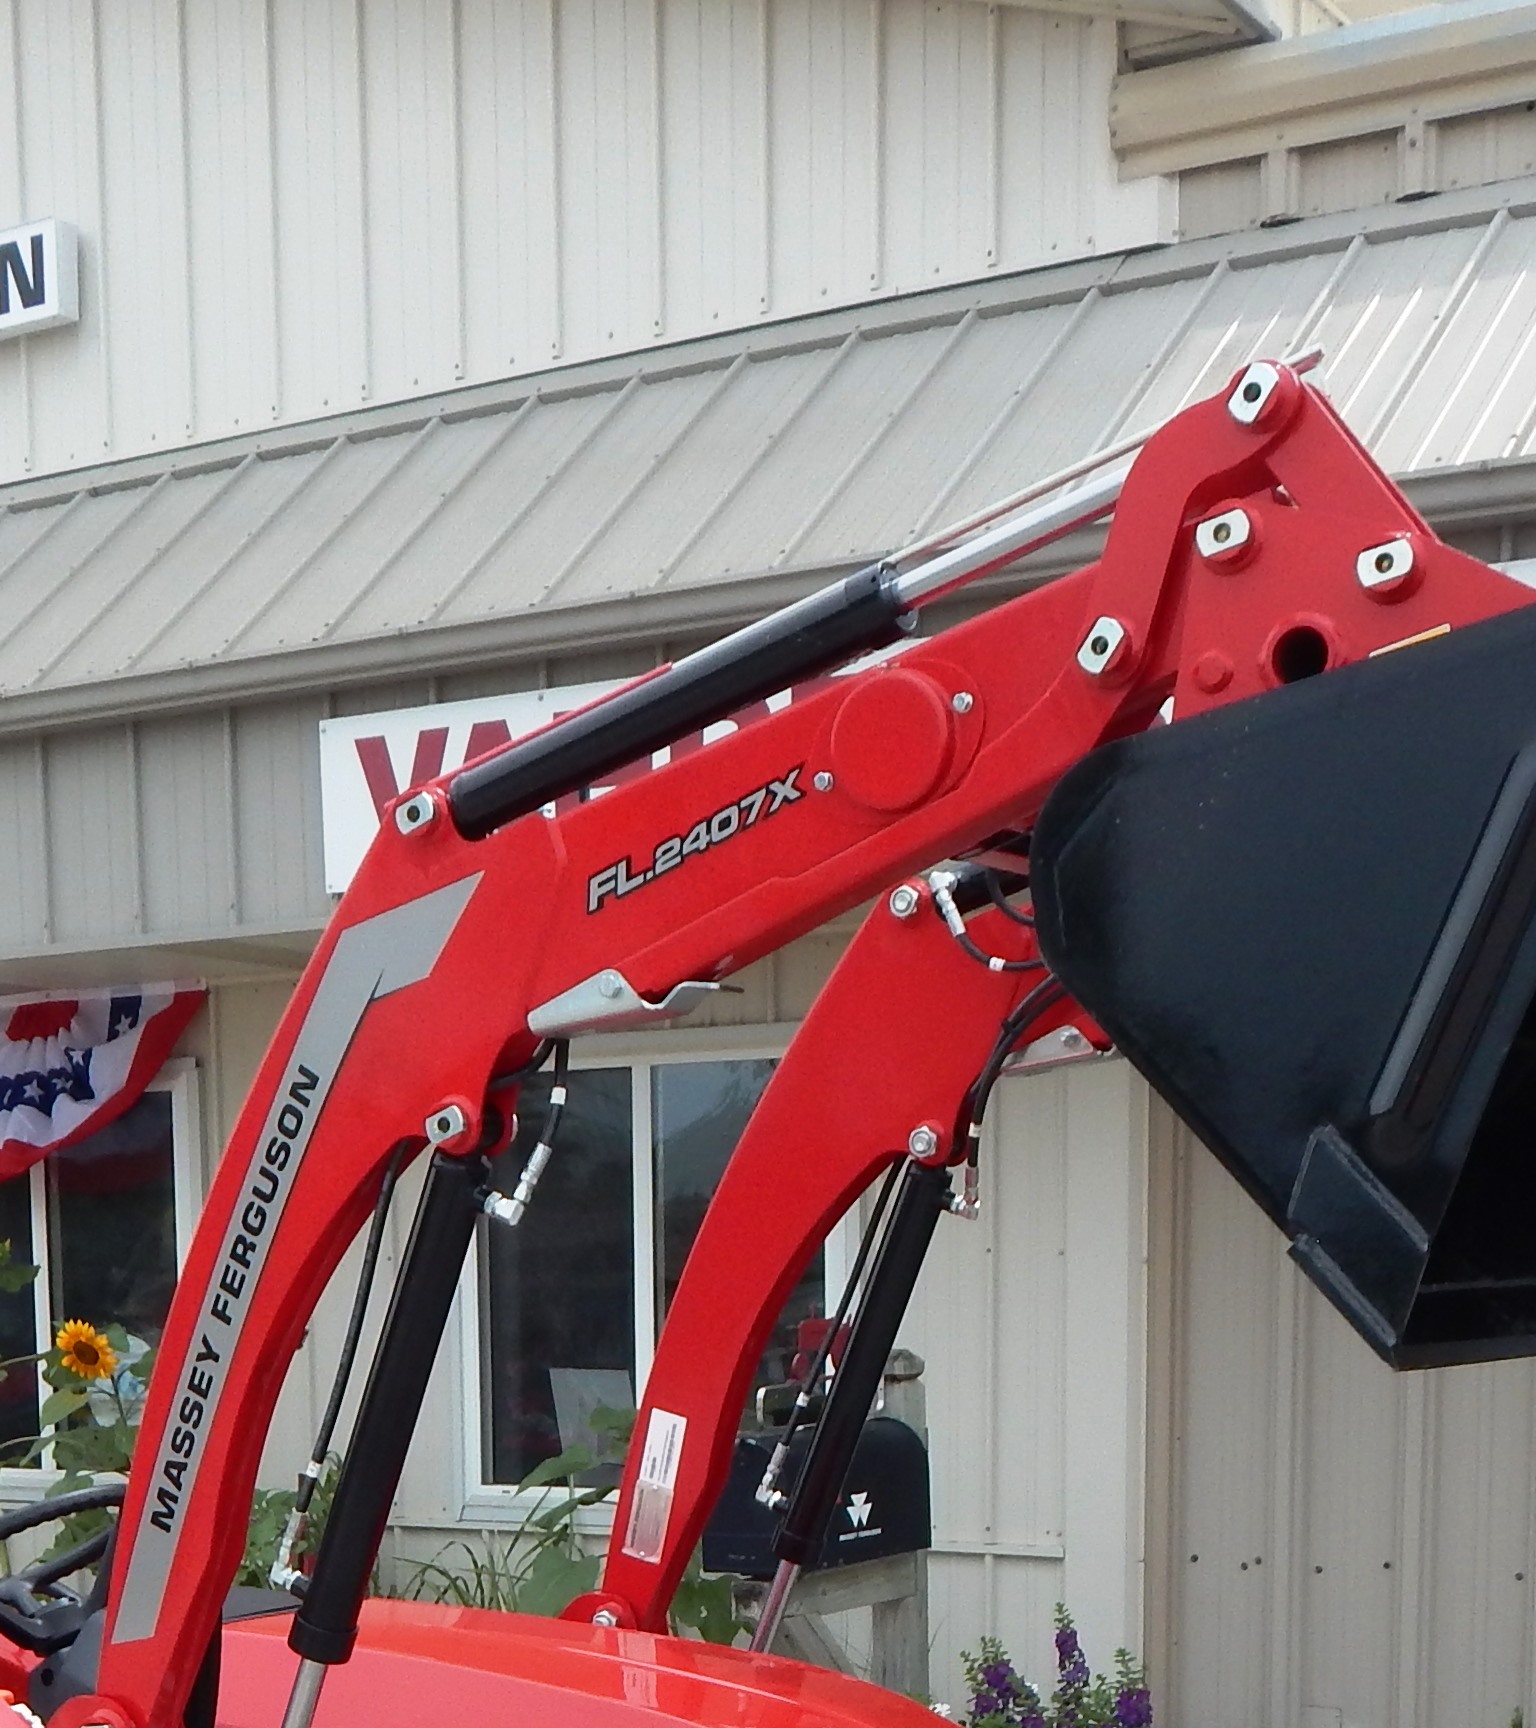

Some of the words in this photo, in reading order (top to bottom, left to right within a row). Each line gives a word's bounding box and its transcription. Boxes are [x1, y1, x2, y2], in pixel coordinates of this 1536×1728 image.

[586, 761, 806, 915] FL.2407X
[149, 1333, 221, 1533] MASSEY
[210, 1064, 320, 1326] FERGUSON
